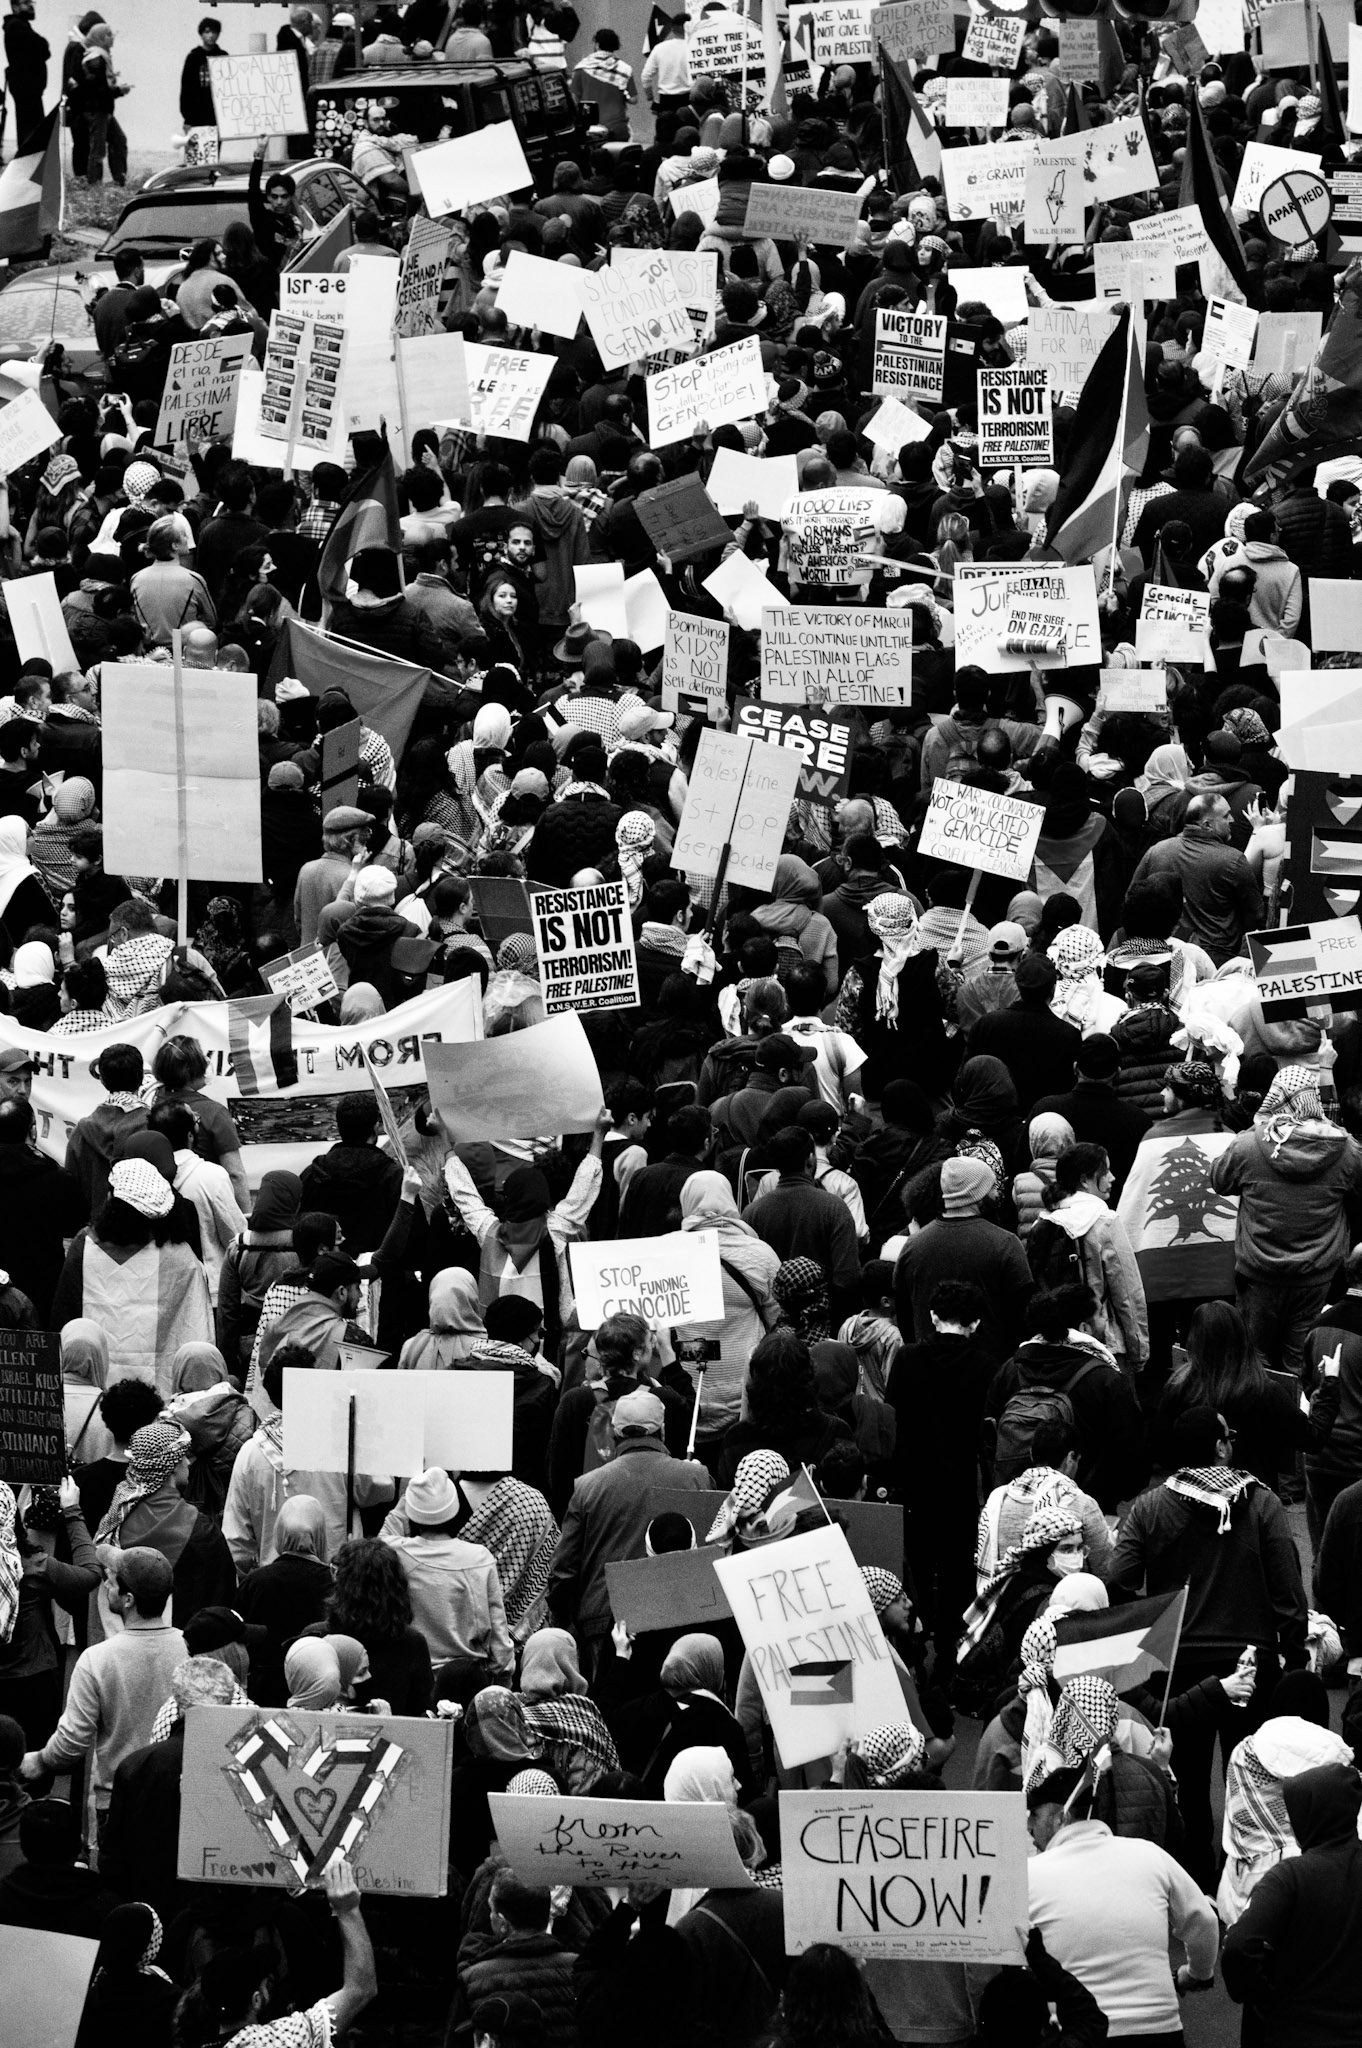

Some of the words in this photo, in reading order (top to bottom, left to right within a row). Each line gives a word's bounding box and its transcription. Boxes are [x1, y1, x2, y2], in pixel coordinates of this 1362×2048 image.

[814, 10, 833, 22] WE
[837, 8, 862, 20] WILL
[872, 21, 908, 39] LIVES
[917, 13, 941, 27] ARE
[974, 14, 1010, 31] ISRAEL
[697, 35, 719, 46] THEY
[817, 25, 835, 37] NOT
[839, 23, 862, 36] GIVE
[919, 24, 955, 41] TORN
[970, 25, 1017, 44] KILLING
[691, 48, 703, 58] TO
[705, 45, 728, 56] BURY
[730, 43, 742, 53] US
[817, 43, 832, 56] ON
[210, 58, 239, 81] GOD
[250, 56, 298, 76] ALLAH
[688, 59, 710, 69] THEY
[215, 75, 259, 98] WILL
[262, 73, 294, 96] NOT
[785, 84, 815, 98] SIEGE
[221, 95, 294, 118] FORGIVE
[1033, 156, 1077, 167] PALESTINE
[402, 263, 436, 289] DEMAND
[437, 261, 444, 275] A
[583, 261, 633, 302] STOP
[398, 277, 440, 307] CEASEFIRE
[601, 280, 678, 327] FUNDING
[881, 312, 943, 339] VICTORY
[1033, 311, 1091, 337] LATINA
[899, 333, 908, 343] TO
[910, 335, 923, 346] THE
[1041, 337, 1067, 354] FOR
[173, 339, 224, 365] DESDE
[172, 366, 186, 379] el
[483, 353, 530, 376] FREE
[876, 353, 943, 376] PALESTINIAN
[1060, 361, 1088, 384] THE
[192, 377, 205, 389] al
[211, 374, 237, 385] mar
[654, 369, 702, 400] Stop
[874, 369, 943, 391] RESISTANCE
[980, 370, 1048, 387] RESISTANCE
[163, 386, 232, 411] PALESTINA
[657, 383, 756, 431] GENOCIDE!
[982, 387, 1002, 416] IS
[1007, 386, 1046, 415] NOT
[166, 410, 223, 443] LIBRE
[980, 420, 1050, 438] TERRORISM!
[982, 440, 1004, 453] FREE
[1003, 439, 1050, 452] PALESTINE!
[1021, 454, 1050, 463] Coalition
[838, 498, 874, 512] LIVES
[803, 525, 853, 538] ORPHANS
[860, 516, 870, 525] OF
[798, 535, 841, 547] WIDOWS
[798, 566, 831, 583] WORTH
[1148, 586, 1199, 606] Genocide
[669, 612, 728, 646] Bombing
[765, 610, 801, 626] THE
[803, 612, 853, 626] VICTORY
[854, 615, 872, 627] OF
[872, 615, 911, 629] MARCH
[1007, 619, 1027, 636] ON
[1028, 623, 1064, 639] GAZA
[1010, 610, 1028, 622] END
[1028, 611, 1043, 624] THE
[1043, 614, 1066, 627] SIEGE
[673, 633, 720, 662] KIDS
[765, 631, 797, 645] WILL
[798, 632, 859, 646] CONTINUE
[665, 655, 678, 670] is
[690, 658, 724, 682] NOT
[764, 648, 852, 666] PALESTINIAN
[855, 651, 901, 668] FLAGS
[767, 670, 799, 687] FLY
[802, 669, 822, 685] IN
[826, 668, 856, 684] ALL
[856, 669, 875, 683] OF
[804, 684, 905, 705] PALESTINE!
[739, 704, 850, 746] CEASE
[700, 734, 736, 756] Free
[694, 755, 780, 791] Palestine
[686, 797, 778, 837] Stop
[931, 792, 954, 812] NOT
[949, 798, 1031, 838] COMPLICATED
[987, 794, 1047, 823] COLONIALISM
[943, 816, 1023, 855] GENOCIDE
[677, 833, 775, 872] Genocide
[930, 842, 979, 866] CONFLICT
[534, 884, 626, 917] RESISTANCE
[539, 915, 567, 954] IS
[572, 907, 624, 949] NOT
[1317, 935, 1358, 954] FREE
[541, 948, 634, 981] TERRORISM!
[545, 980, 573, 1000] FREE
[574, 972, 635, 996] PALESTINE!
[1257, 969, 1362, 998] PALESTINE
[297, 994, 314, 1005] FREE
[598, 993, 635, 1007] Coalition
[598, 1264, 642, 1288] STOP
[639, 1274, 689, 1296] FUNDING
[602, 1288, 693, 1322] GENOCIDE
[25, 1333, 49, 1349] ARE
[1, 1369, 34, 1386] ISRAEL
[35, 1372, 60, 1390] KILLS
[16, 1409, 46, 1427] SILENT
[747, 1559, 847, 1622] FREE
[752, 1611, 892, 1692] PALESTINE
[541, 1813, 664, 1847] from
[799, 1814, 997, 1865] CEASEFIRE
[533, 1842, 593, 1856] the
[601, 1842, 685, 1860] River
[202, 1847, 239, 1878] Free
[575, 1857, 604, 1869] to
[616, 1860, 671, 1871] the
[836, 1873, 992, 1933] NOW!
